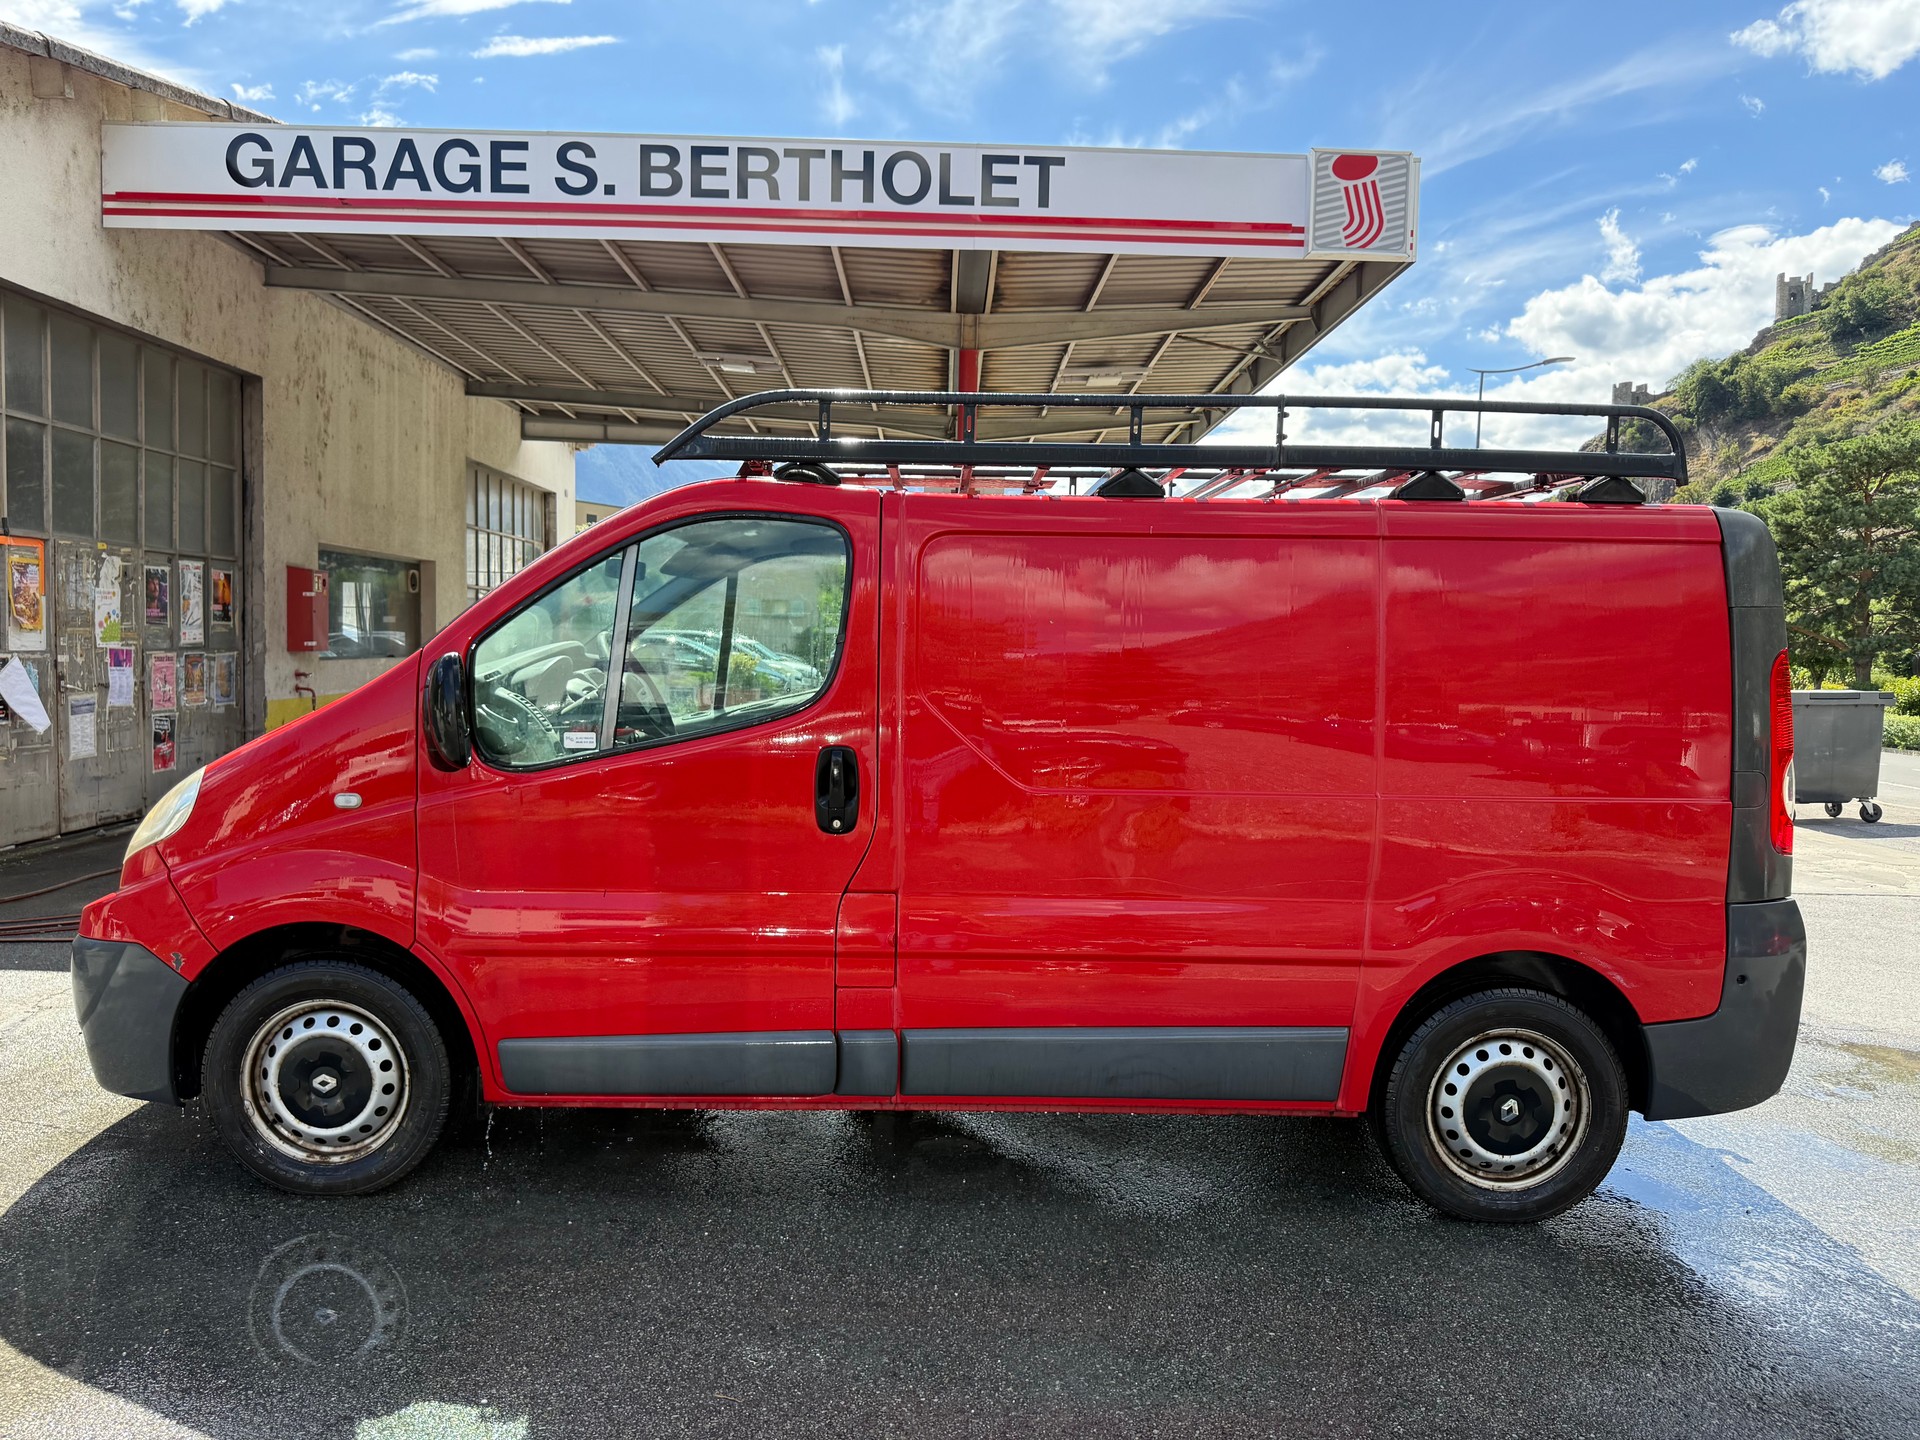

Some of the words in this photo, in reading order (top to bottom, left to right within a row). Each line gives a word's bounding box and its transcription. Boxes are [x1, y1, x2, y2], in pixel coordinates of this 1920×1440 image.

[225, 132, 530, 194] GARAGE
[554, 141, 616, 196] S.
[639, 144, 1066, 209] BERTHOLET
